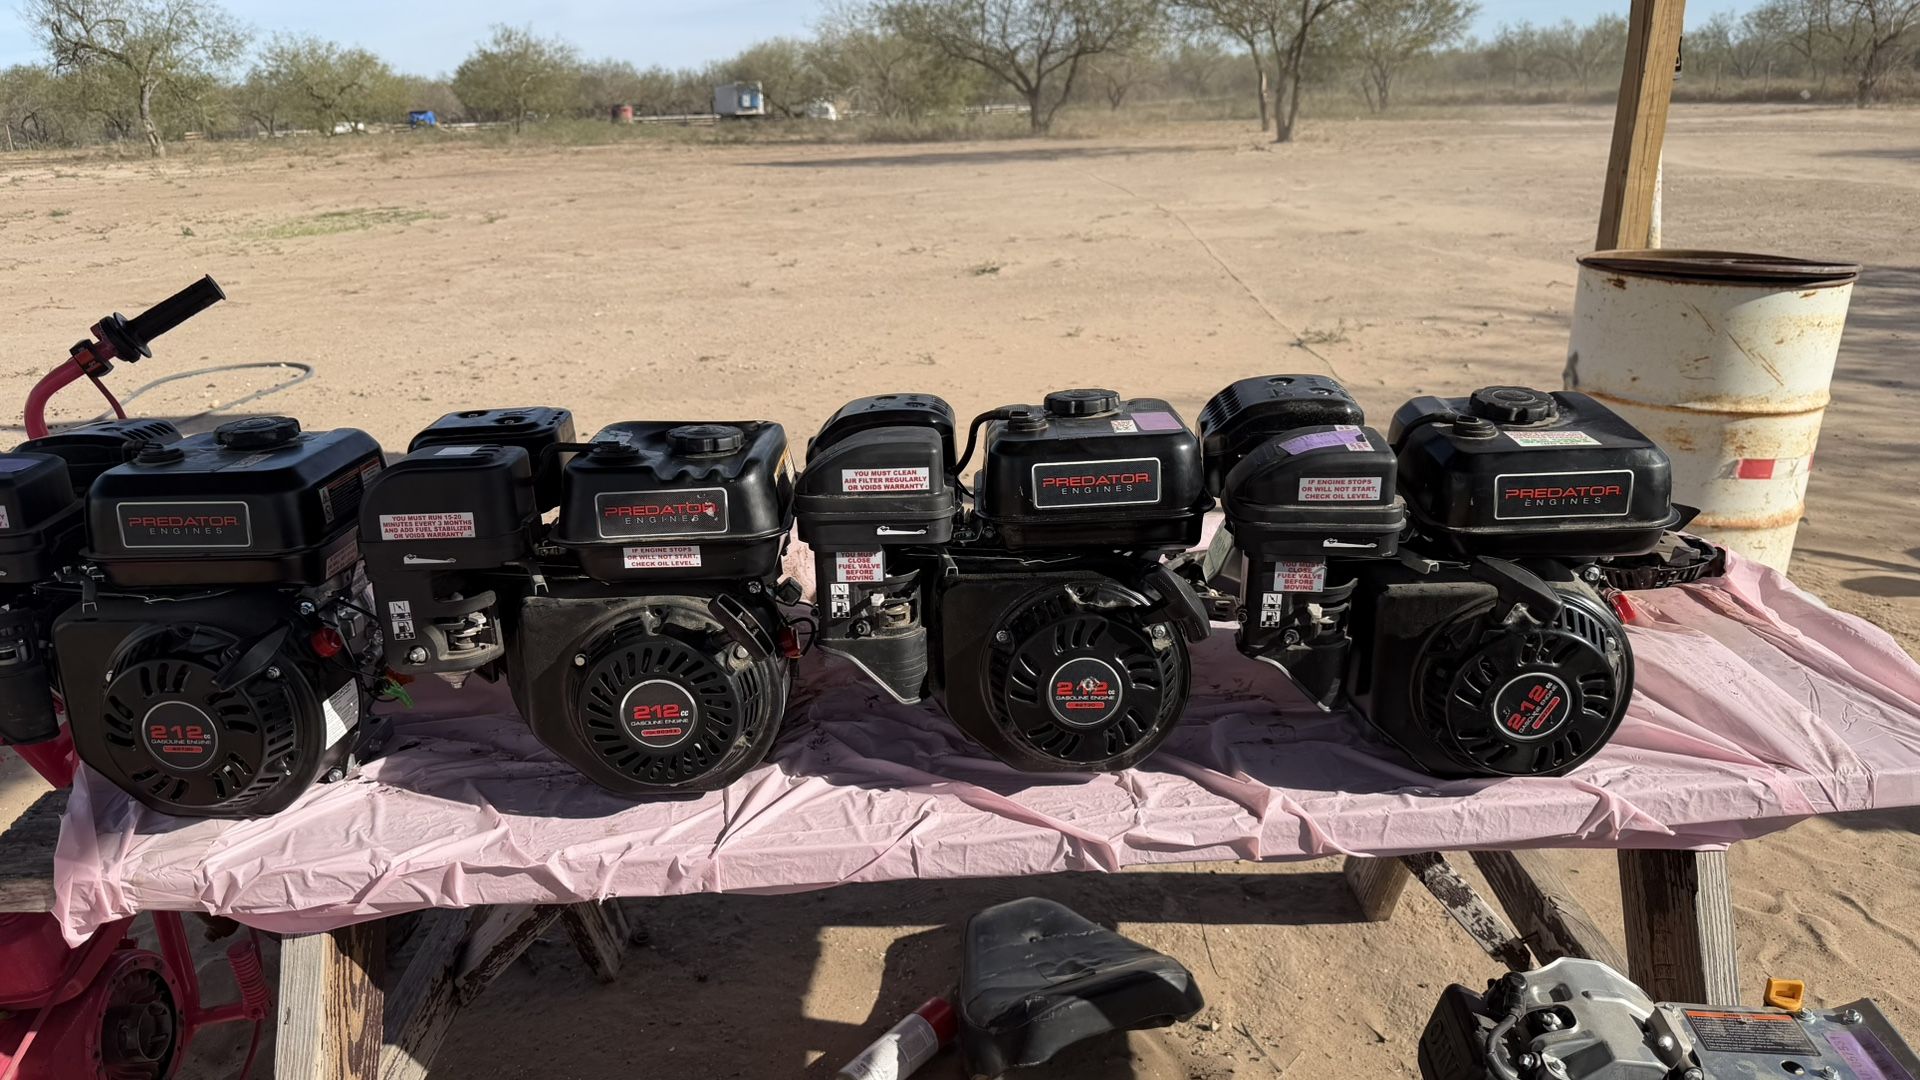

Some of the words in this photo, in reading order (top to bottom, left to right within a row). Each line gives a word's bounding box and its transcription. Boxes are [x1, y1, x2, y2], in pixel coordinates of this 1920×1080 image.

[1042, 473, 1149, 487] PREDATOR
[1062, 485, 1132, 495] ENGINES
[1506, 486, 1620, 499] PREDATOR
[1524, 497, 1601, 506] ENGINES
[604, 502, 718, 516] PREDATOR
[128, 516, 238, 527] PREDATOR
[624, 515, 700, 524] ENGINES
[633, 704, 680, 720] 212
[1506, 684, 1548, 730] 212
[150, 724, 203, 739] 212
